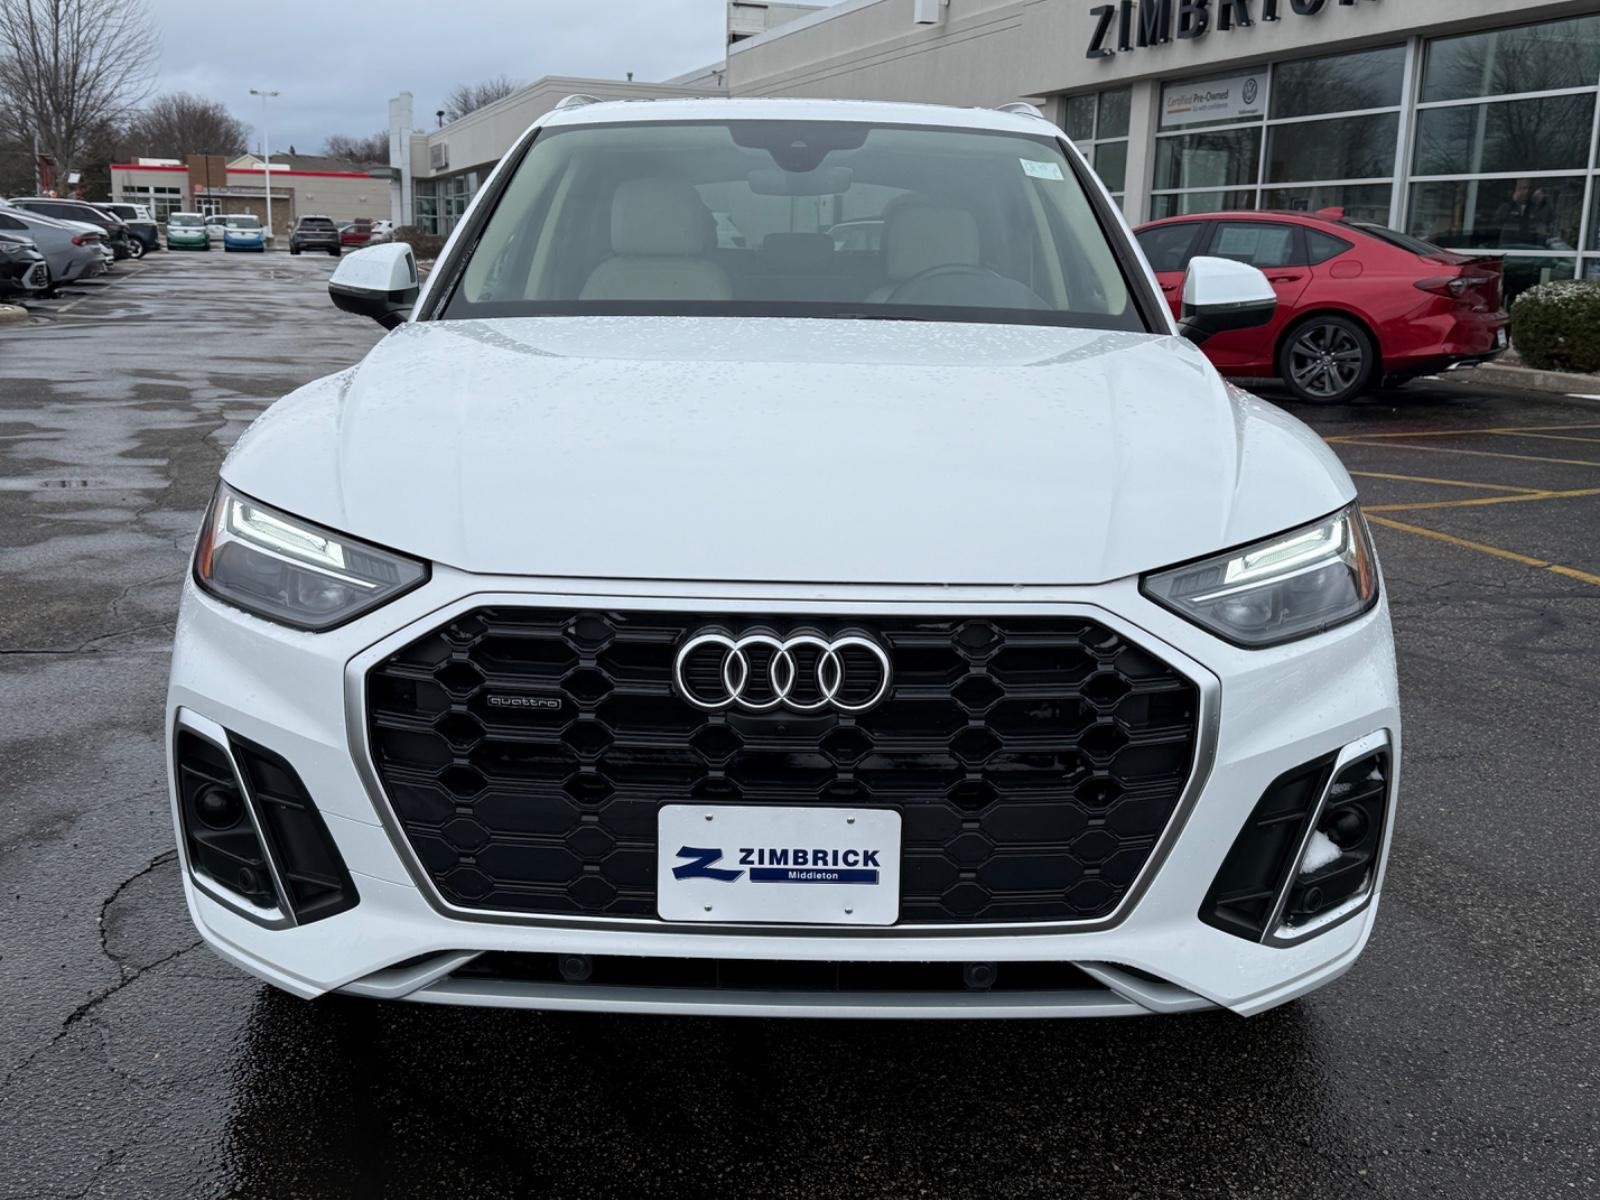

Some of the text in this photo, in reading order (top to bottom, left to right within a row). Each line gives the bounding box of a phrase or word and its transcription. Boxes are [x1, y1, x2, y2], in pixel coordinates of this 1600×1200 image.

[1086, 0, 1380, 58] ZIMBR
[1193, 88, 1229, 103] Pre-Owned
[491, 697, 558, 707] quattro
[738, 848, 880, 867] ZIMBRICK
[788, 871, 839, 880] Middleton
